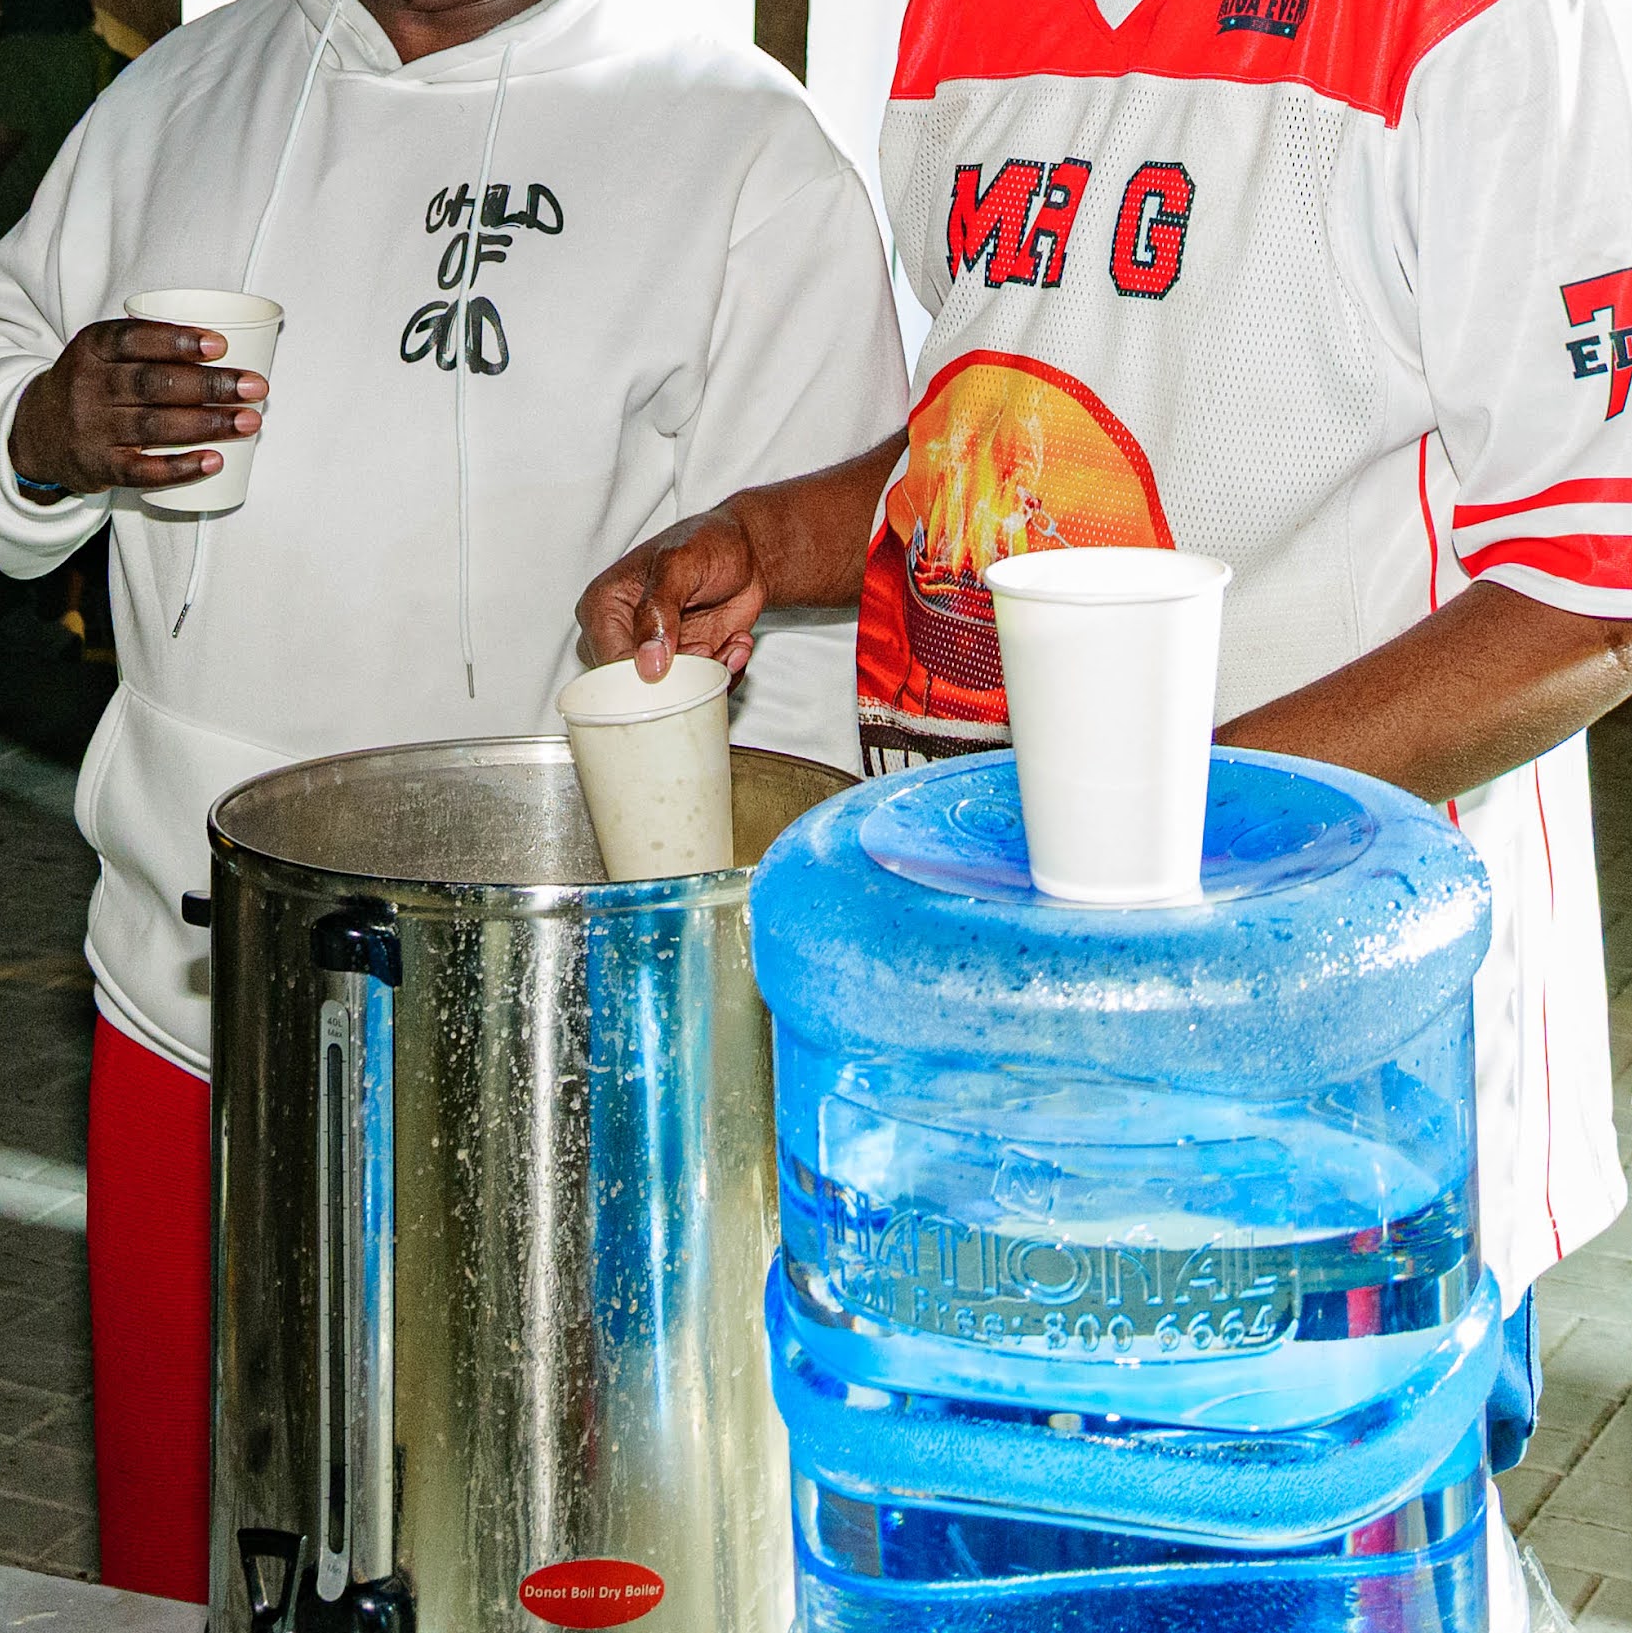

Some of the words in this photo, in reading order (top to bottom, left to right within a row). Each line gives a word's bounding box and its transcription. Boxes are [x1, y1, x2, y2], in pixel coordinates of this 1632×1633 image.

[425, 182, 564, 235] CHILD
[1109, 160, 1196, 301] G
[437, 231, 513, 290] OF
[400, 296, 510, 376] GOD
[1042, 1311, 1135, 1353] 800
[1154, 1302, 1277, 1353] 6664
[524, 1584, 567, 1599] Donot
[570, 1586, 596, 1599] Boil
[598, 1586, 622, 1601] Dry
[624, 1583, 662, 1598] Boiler
